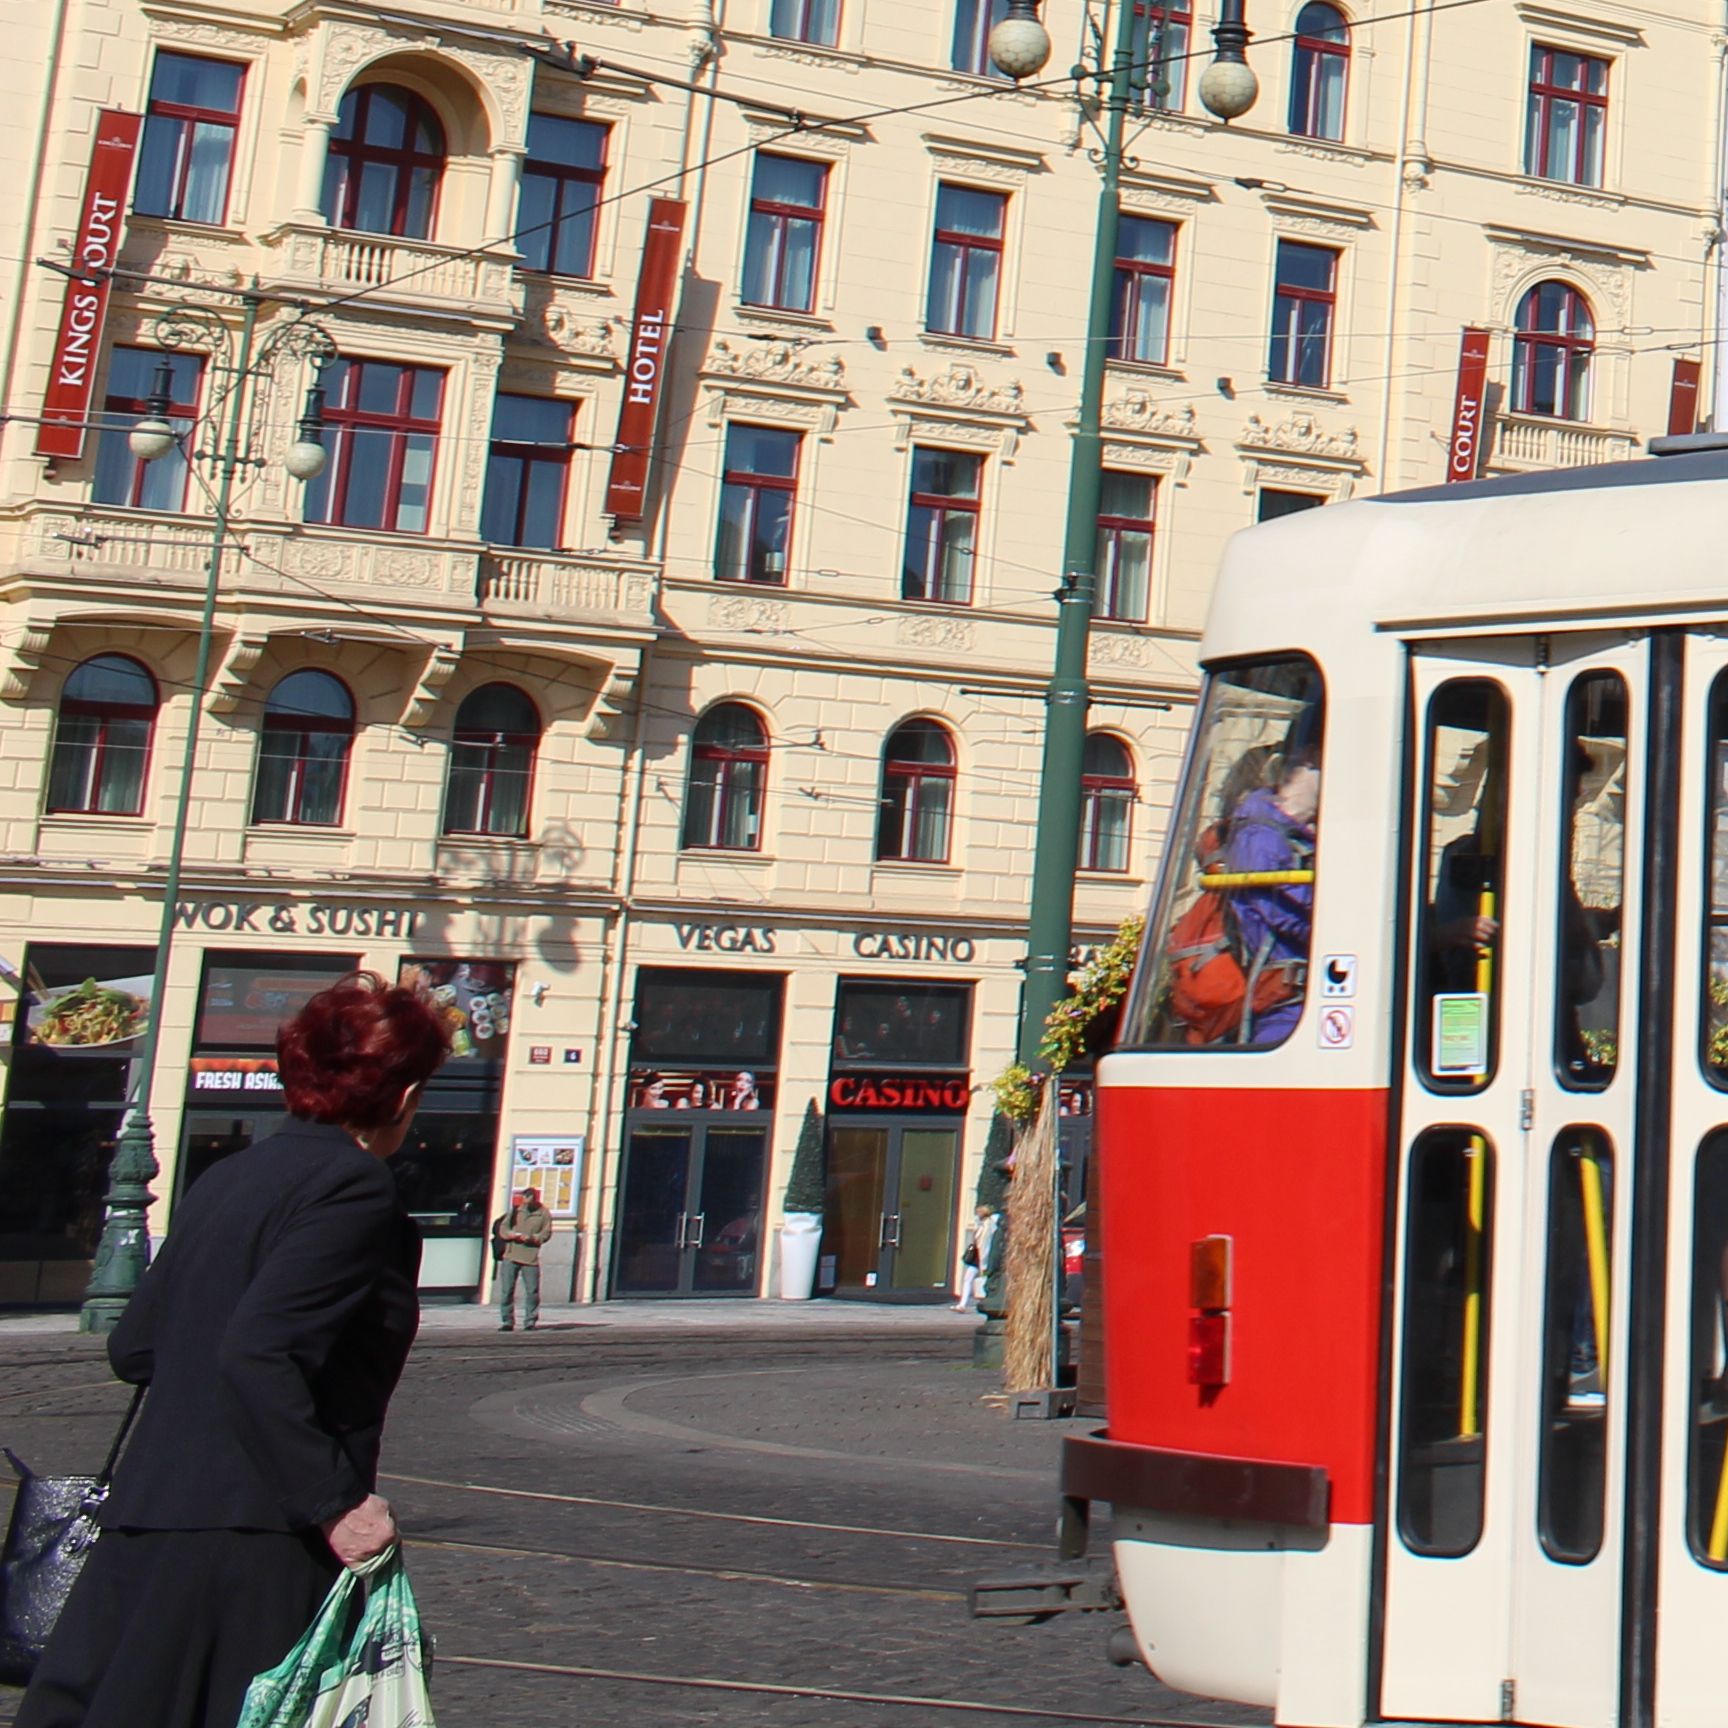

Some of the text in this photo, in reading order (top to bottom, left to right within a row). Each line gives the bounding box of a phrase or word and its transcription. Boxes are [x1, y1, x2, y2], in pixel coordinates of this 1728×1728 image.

[58, 295, 98, 388] KINGS
[81, 192, 118, 287] OURT
[628, 309, 664, 404] HOTEL
[1452, 395, 1478, 473] COURT
[173, 900, 417, 937] WOK & SUSHI
[674, 923, 777, 954] VEGAS
[854, 932, 976, 963] CASINO
[195, 1071, 243, 1090] FRESH
[830, 1077, 969, 1109] CASINO
